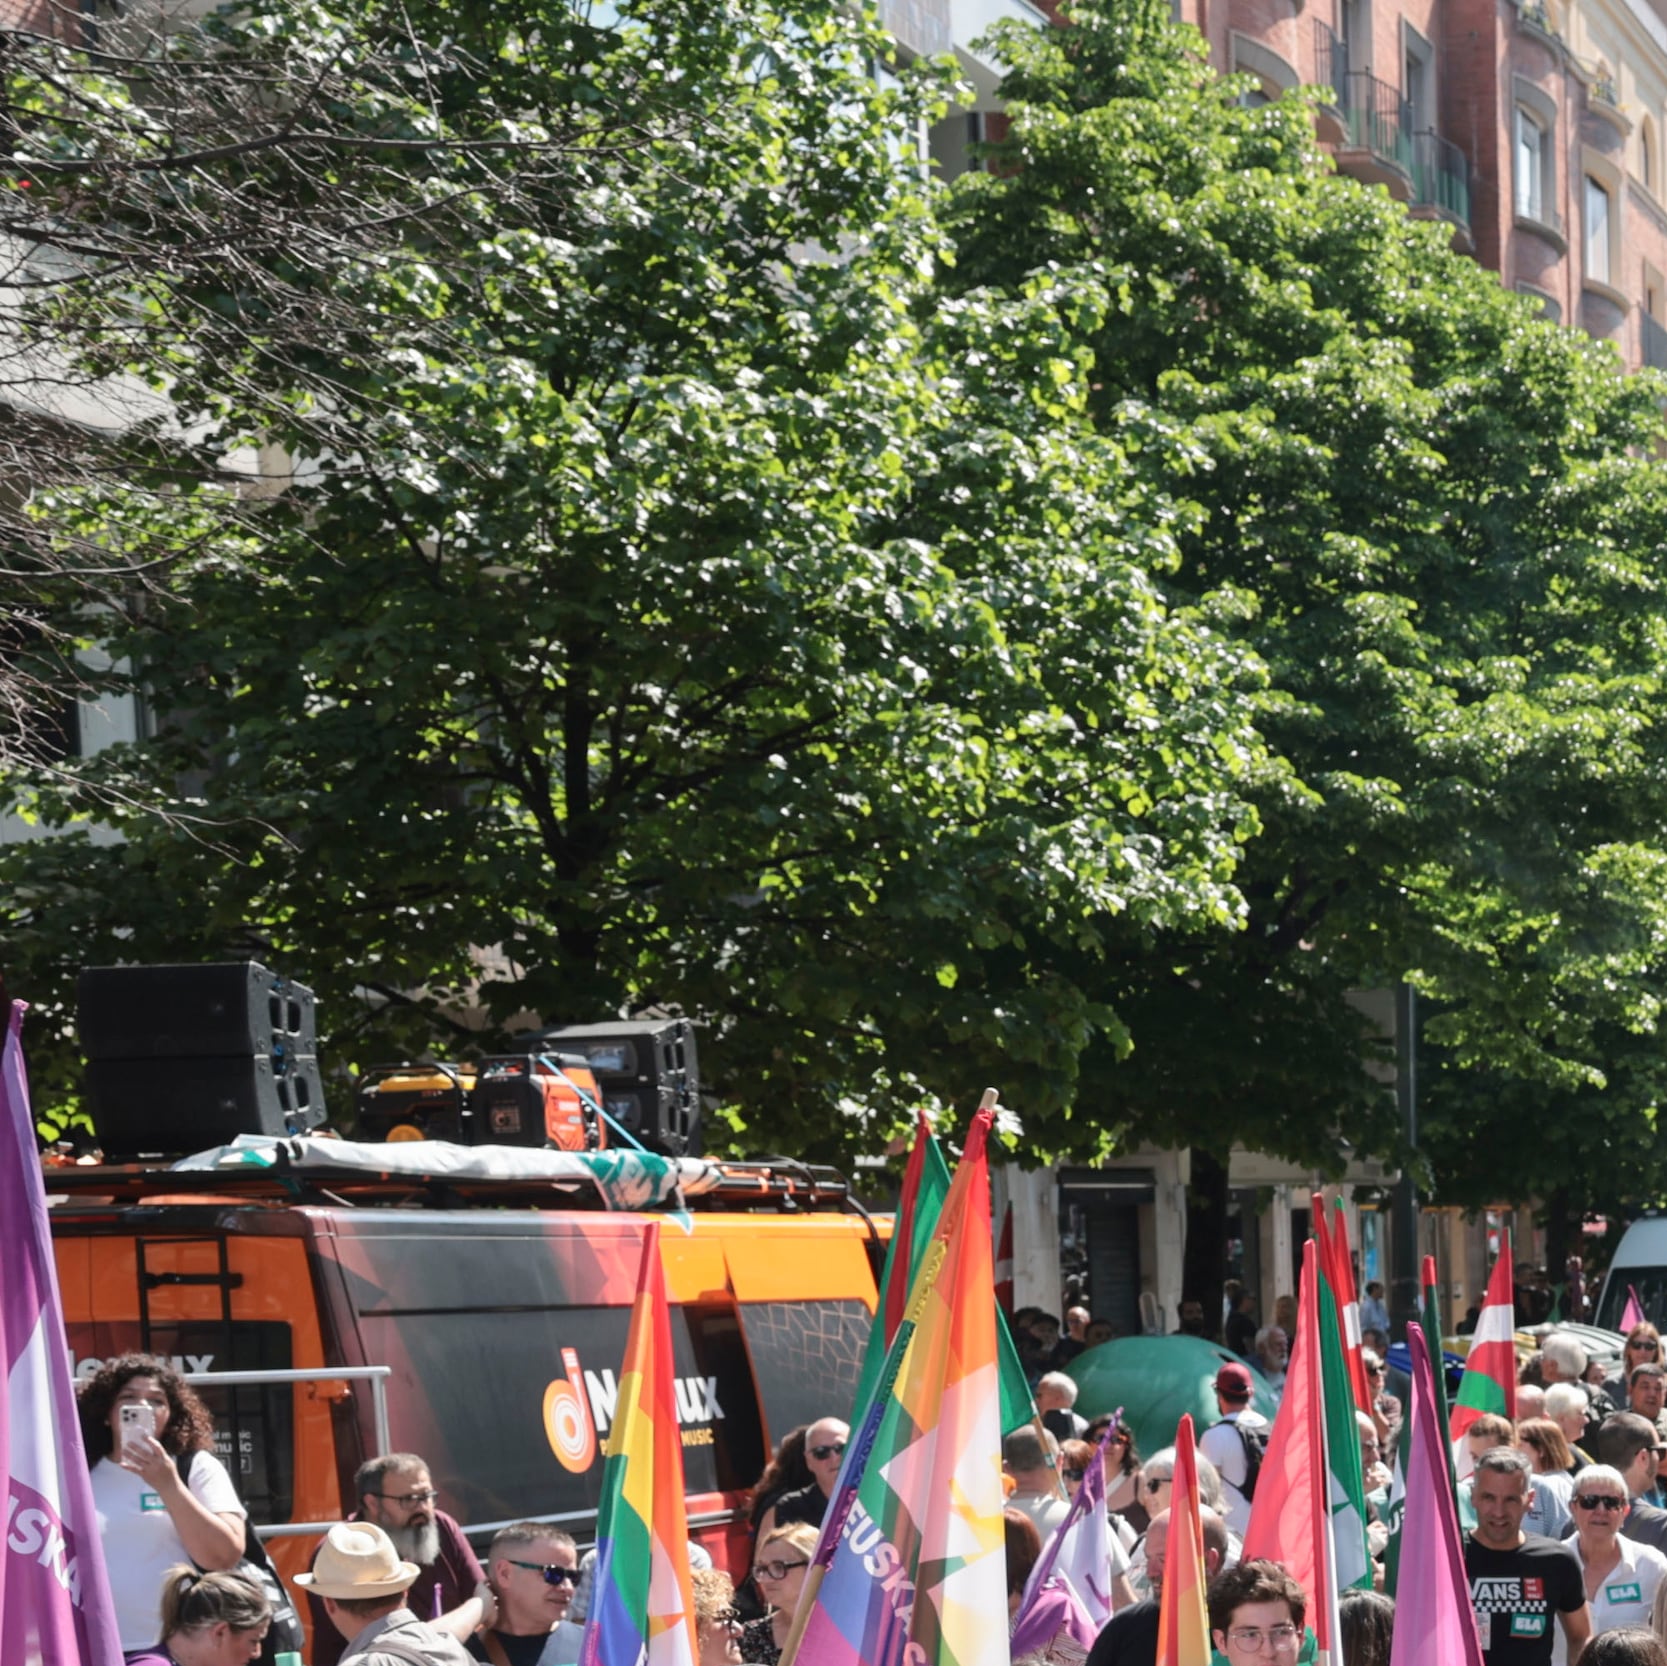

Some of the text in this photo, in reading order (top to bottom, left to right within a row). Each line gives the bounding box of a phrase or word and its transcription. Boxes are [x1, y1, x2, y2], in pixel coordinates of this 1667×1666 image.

[841, 1505, 916, 1638] EUSKA
[1467, 1577, 1521, 1601] VANS
[1609, 1586, 1639, 1599] ELA
[1514, 1617, 1542, 1631] ELA
